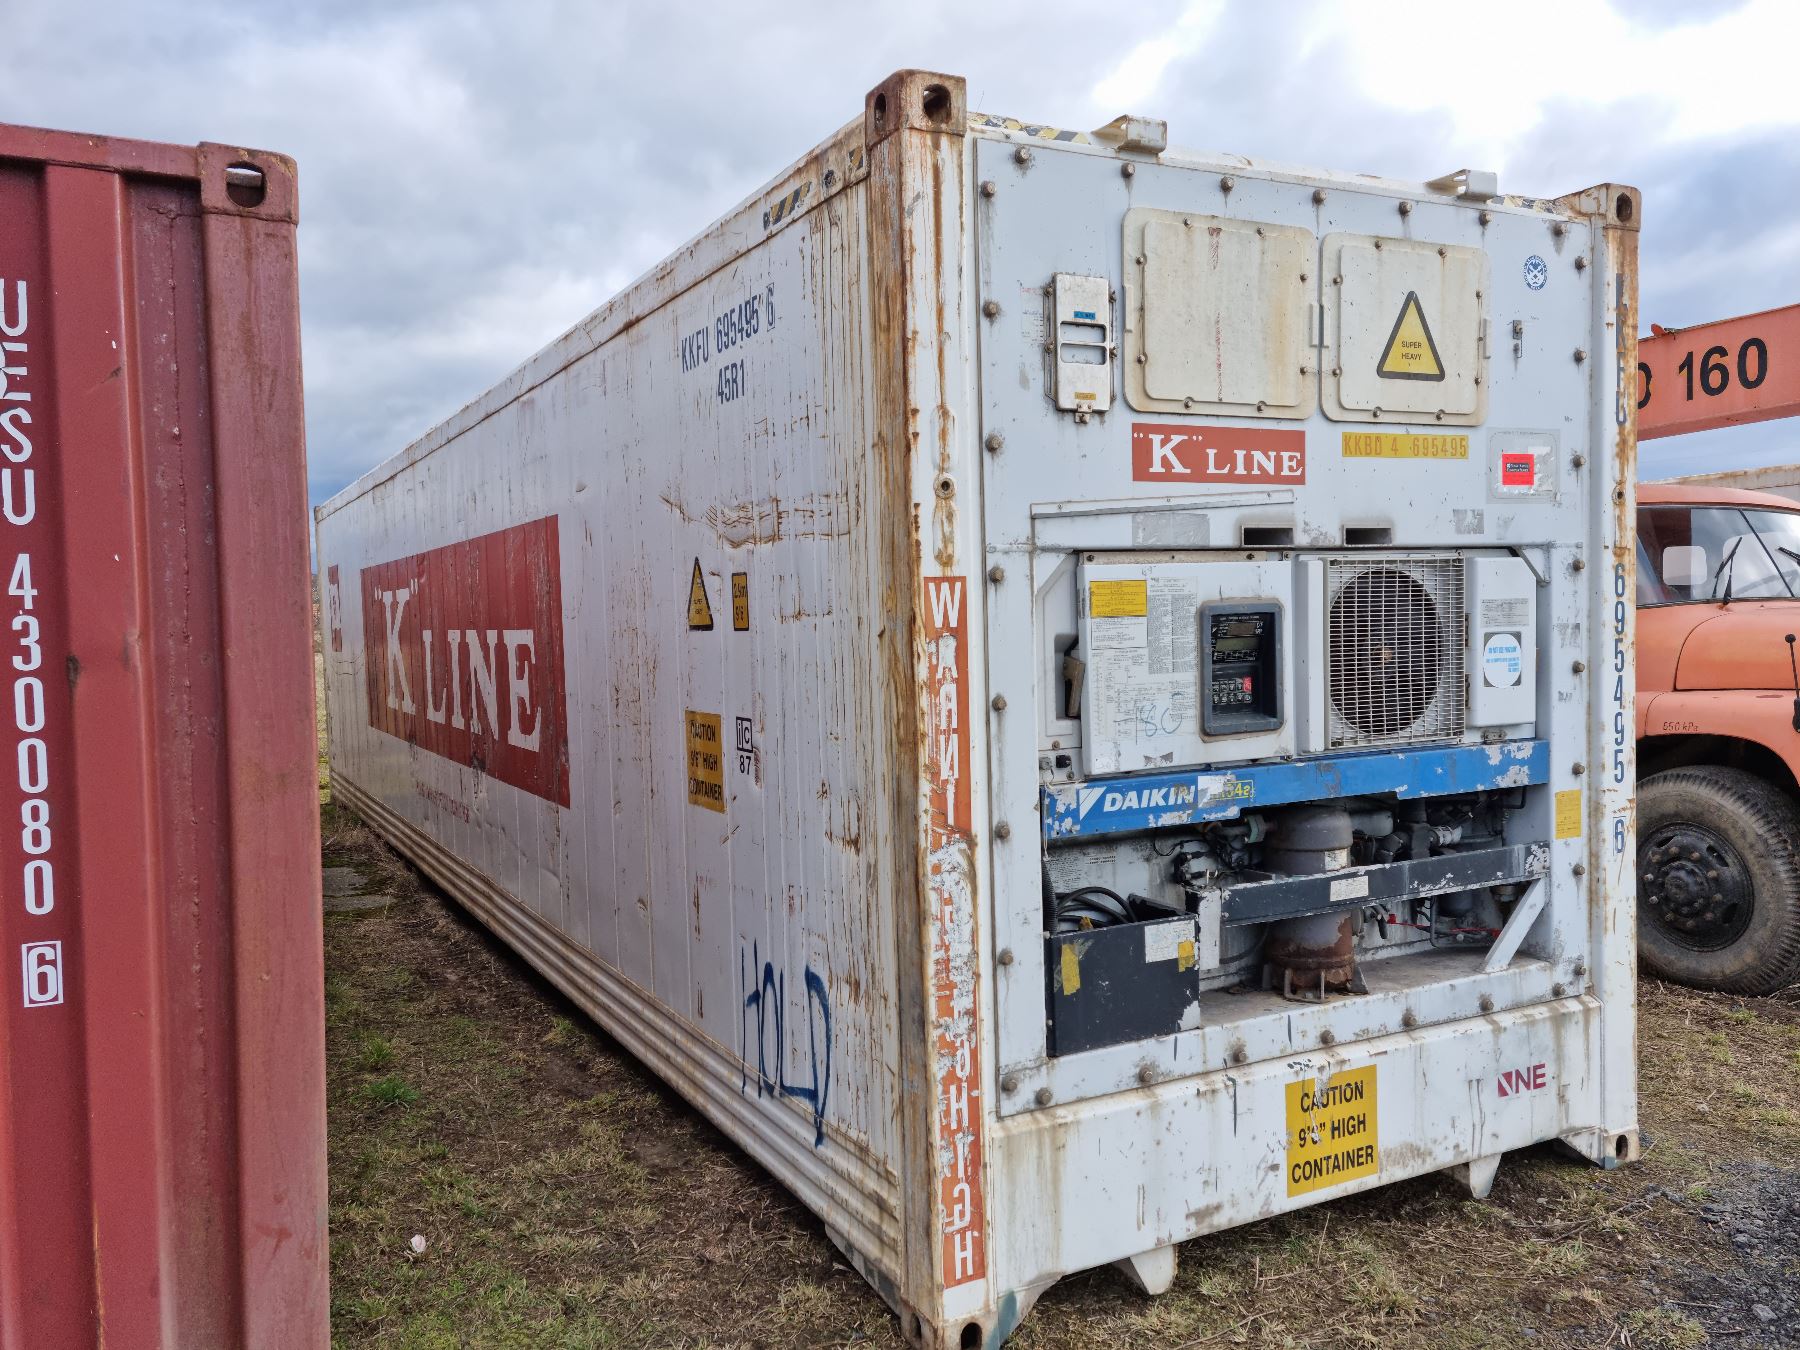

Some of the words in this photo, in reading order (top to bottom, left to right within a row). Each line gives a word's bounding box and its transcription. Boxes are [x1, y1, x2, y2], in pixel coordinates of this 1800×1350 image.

[682, 325, 709, 373] KKFU
[715, 295, 760, 353] 695495
[767, 285, 775, 327] 6
[1401, 340, 1422, 349] SUPER
[1401, 352, 1422, 361] HEAVY
[1678, 337, 1768, 401] 160
[717, 358, 745, 405] 45R1
[1206, 448, 1303, 476] LINE
[1412, 437, 1467, 457] 695495
[1614, 562, 1626, 785] 695495
[422, 629, 543, 753] LINE
[8, 553, 55, 915] 430080
[703, 752, 718, 772] HIGH
[739, 754, 752, 776] 87
[1103, 785, 1196, 812] DAIKIN
[1614, 818, 1625, 854] 6
[27, 946, 58, 1002] 6
[1301, 1080, 1364, 1113] CAUTION
[1331, 1113, 1366, 1140] HIGH
[1291, 1144, 1374, 1184] CONTAINER
